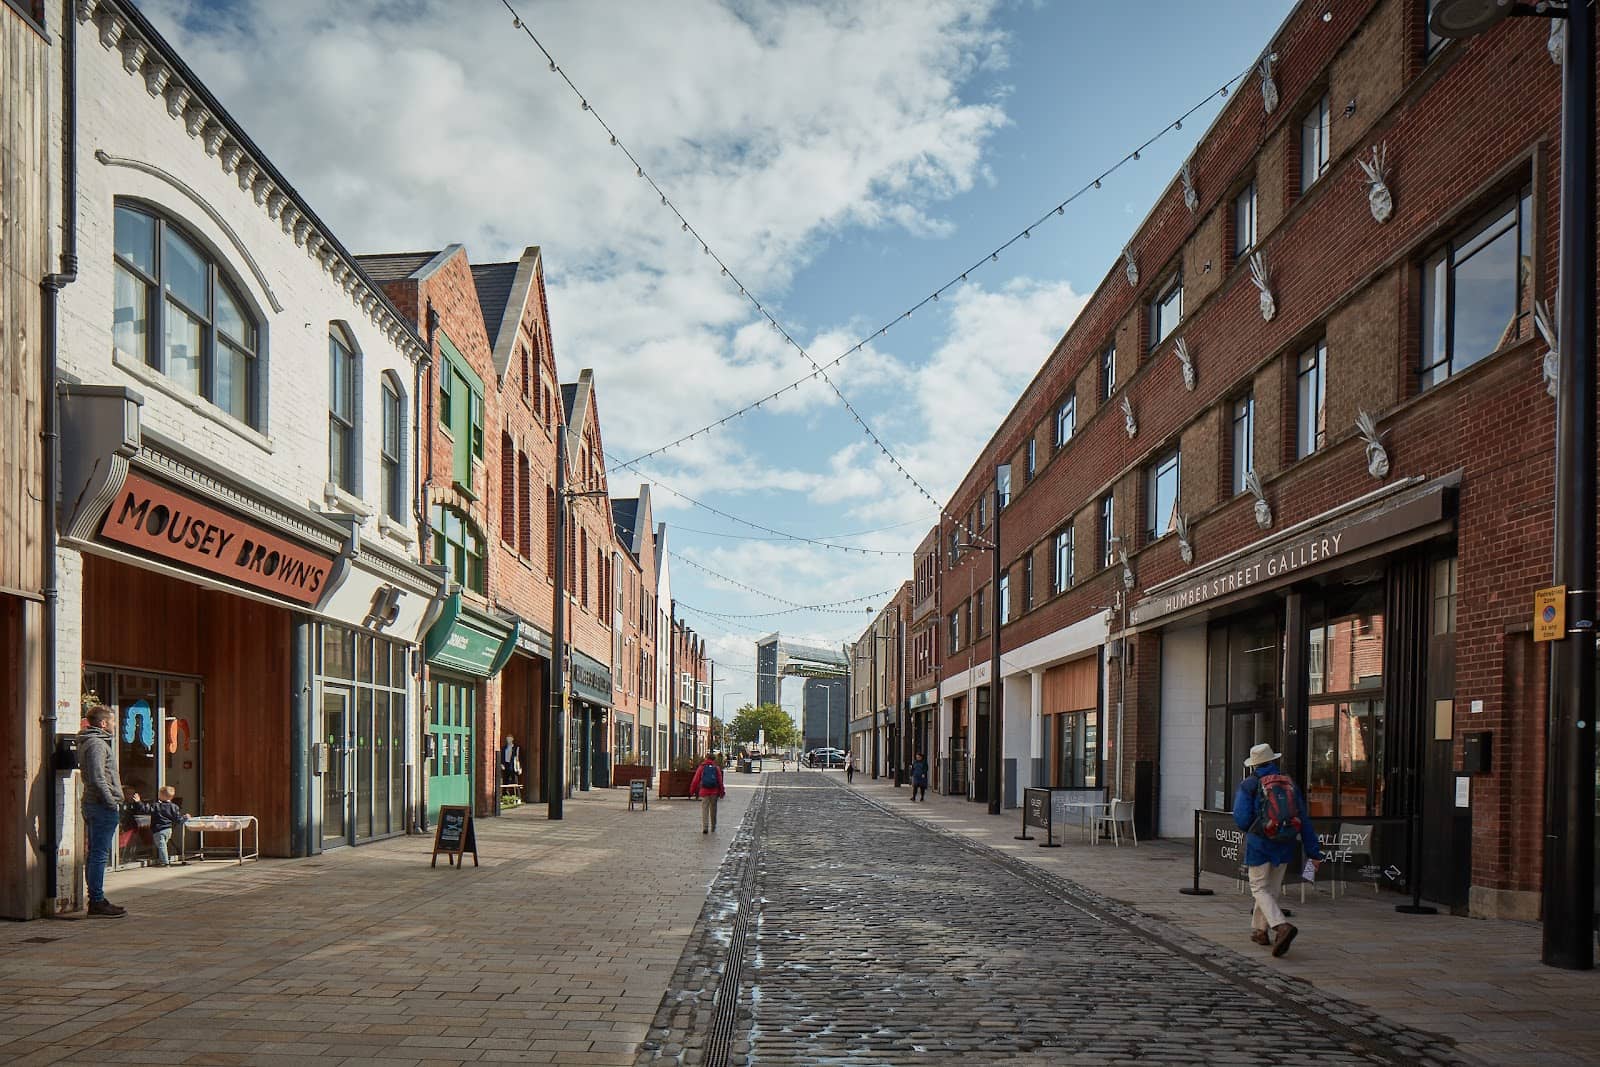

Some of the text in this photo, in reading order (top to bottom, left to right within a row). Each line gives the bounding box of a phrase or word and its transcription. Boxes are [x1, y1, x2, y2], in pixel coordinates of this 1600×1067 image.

[117, 491, 324, 592] MOUSEY BROWN'S
[1165, 533, 1342, 612] HUMBER STREET GALLERY
[1215, 828, 1243, 844] GALLERY
[1317, 833, 1368, 846] ALLERY
[1221, 845, 1238, 861] CAFÉ
